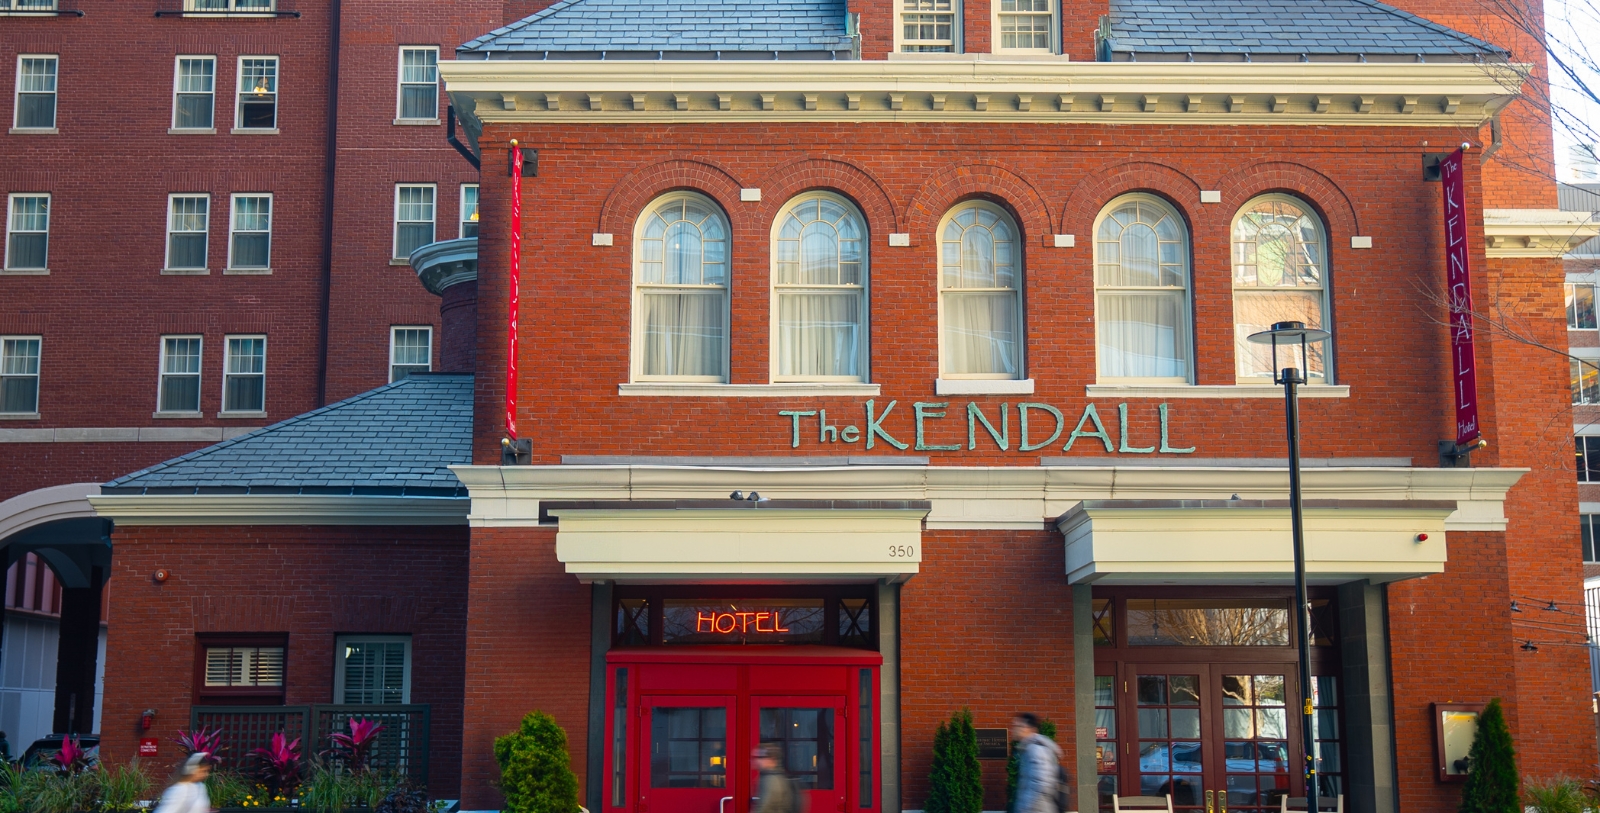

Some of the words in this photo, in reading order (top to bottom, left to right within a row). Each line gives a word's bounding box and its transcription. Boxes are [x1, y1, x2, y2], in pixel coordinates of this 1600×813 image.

[1443, 160, 1458, 179] The
[1446, 181, 1470, 409] KENDALL
[778, 408, 860, 448] The
[866, 399, 1196, 454] KENDALL
[1457, 415, 1476, 440] Hotel
[888, 545, 914, 558] 350
[696, 611, 790, 634] HOTEL
